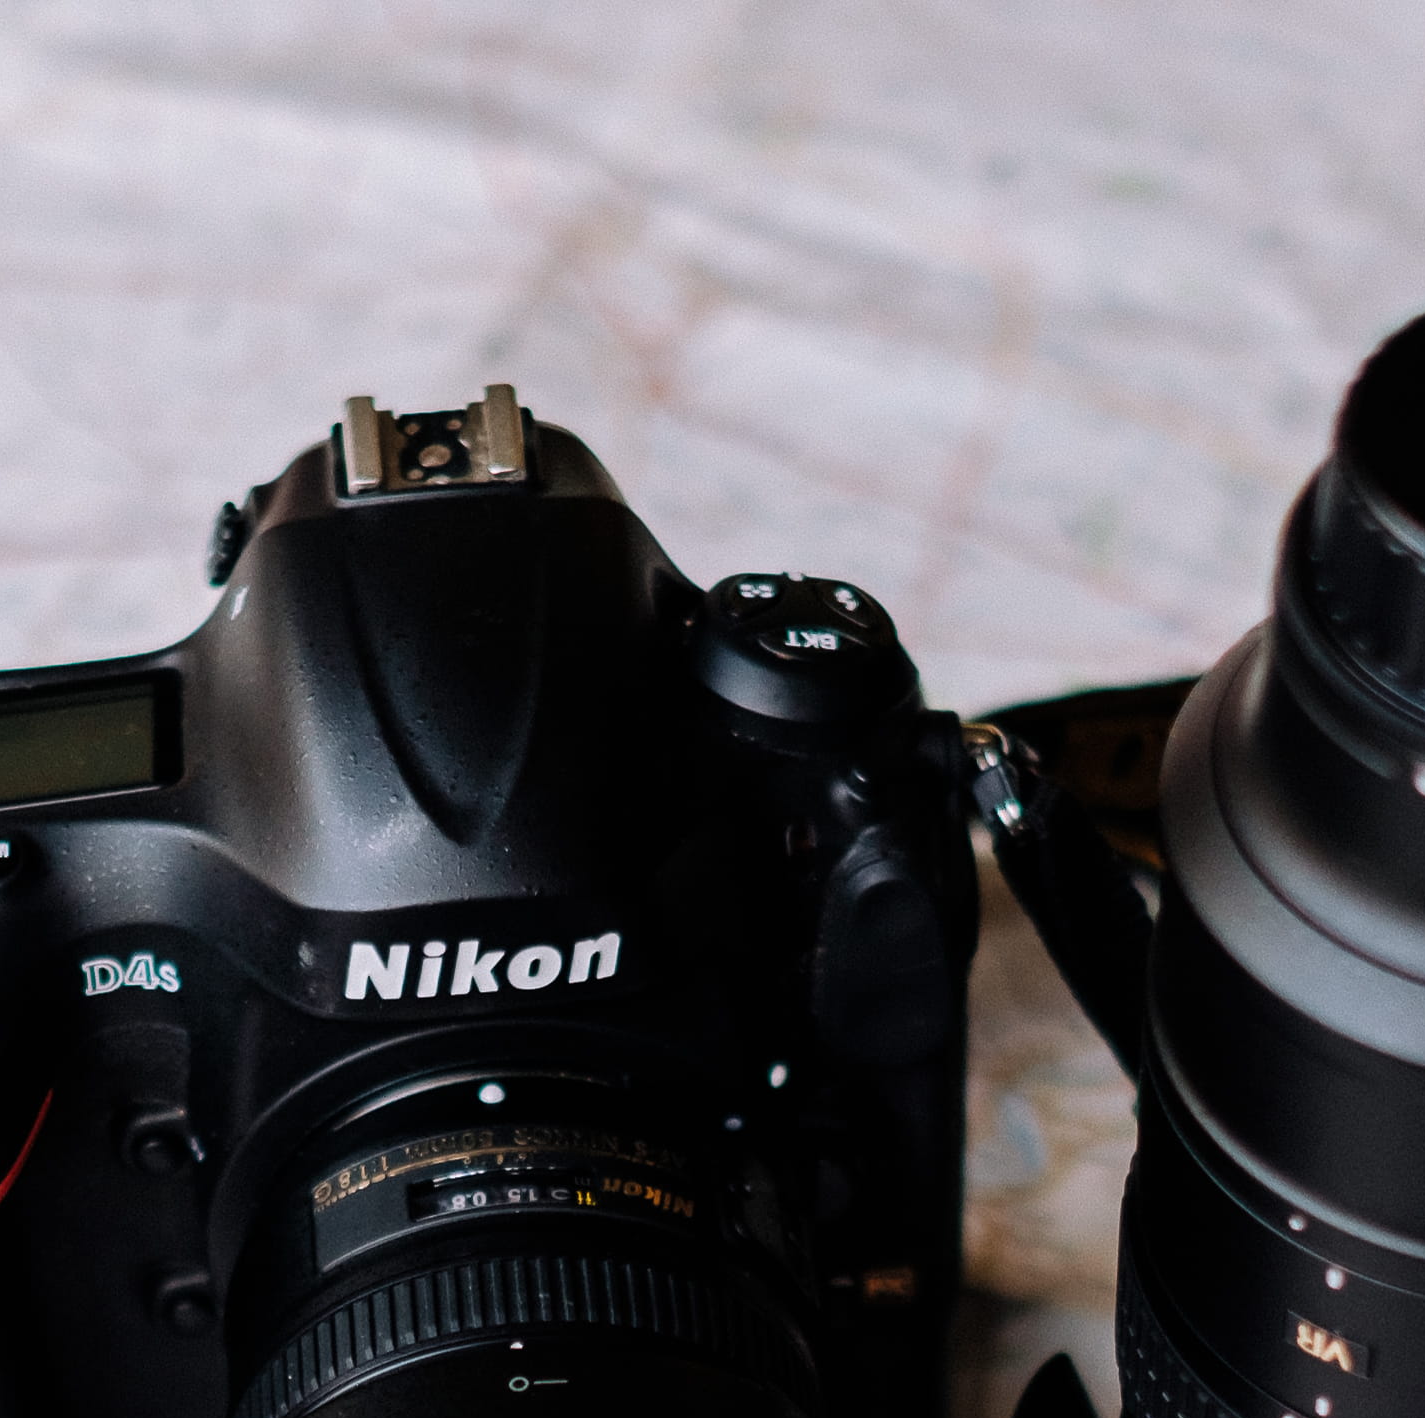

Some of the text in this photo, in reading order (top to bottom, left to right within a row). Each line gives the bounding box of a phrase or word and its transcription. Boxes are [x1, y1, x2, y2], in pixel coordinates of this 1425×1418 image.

[785, 630, 838, 650] BKT
[344, 932, 622, 1000] Nikon
[452, 1188, 537, 1210] 0.8 1.5
[603, 1177, 695, 1218] Nikon
[1294, 1322, 1355, 1372] VR
